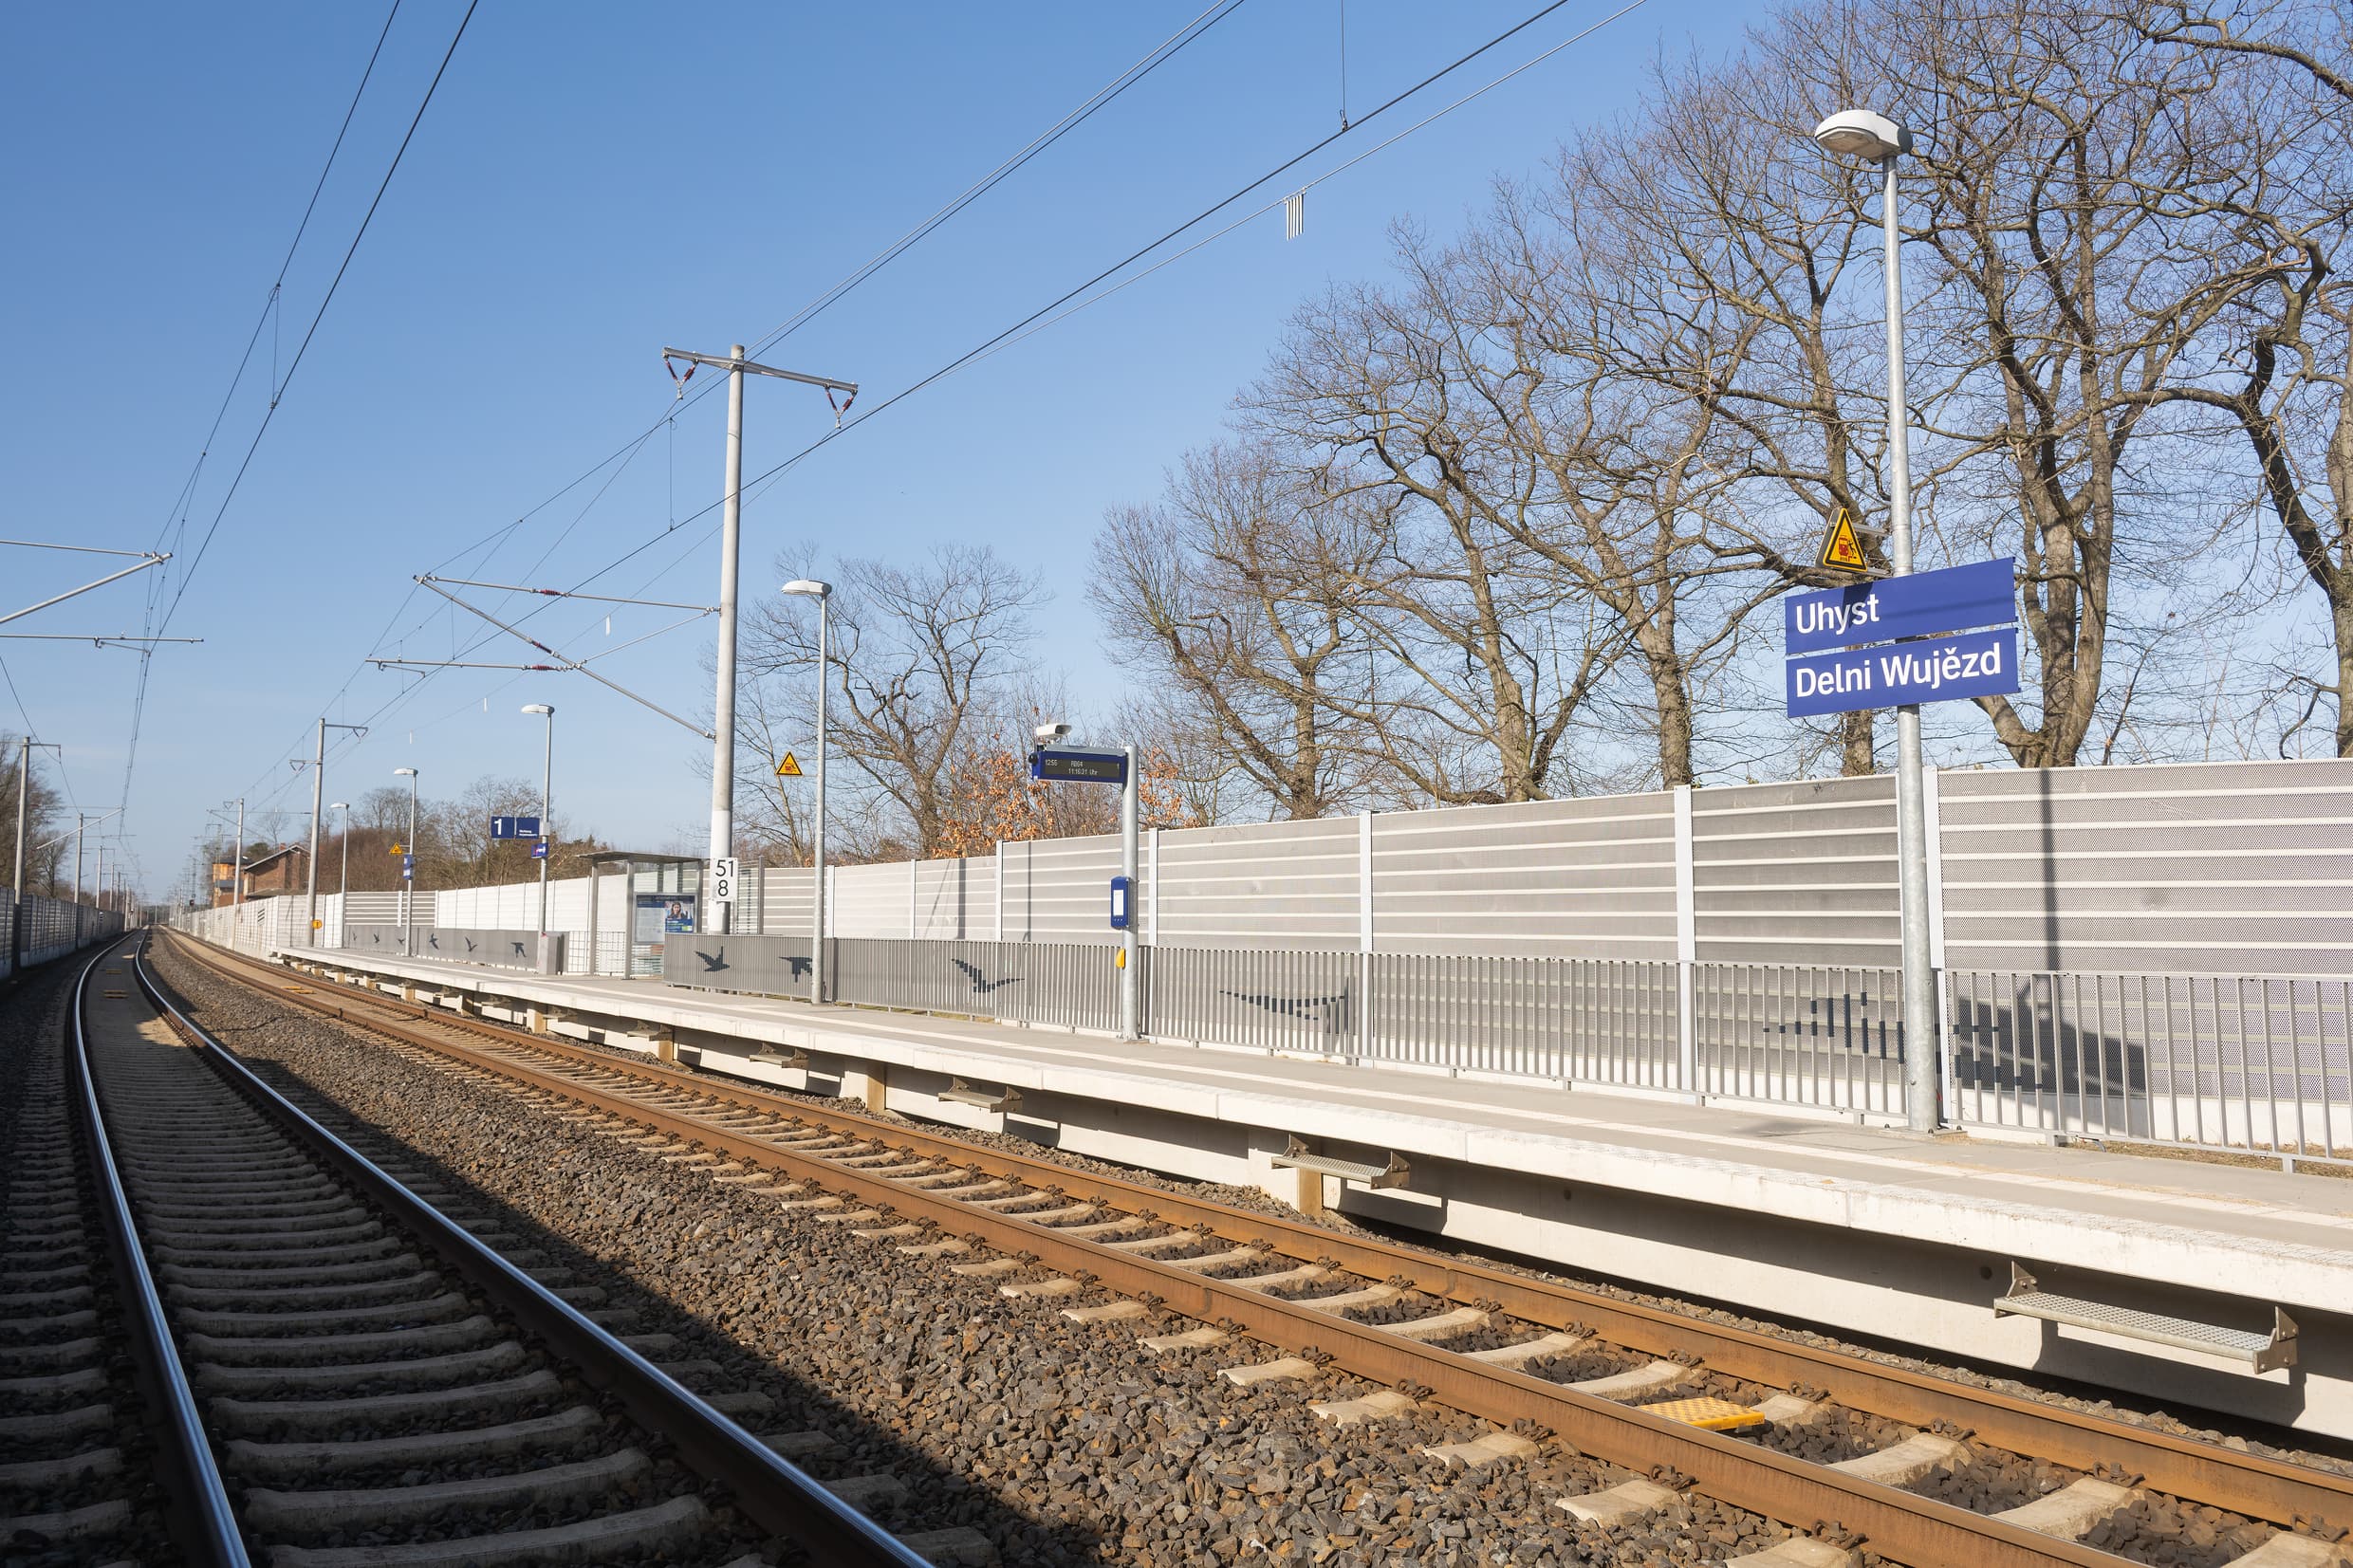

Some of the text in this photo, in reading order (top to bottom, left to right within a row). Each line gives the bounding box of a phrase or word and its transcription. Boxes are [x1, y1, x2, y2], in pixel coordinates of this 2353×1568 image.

[1795, 594, 1880, 636] Uhyst
[1795, 642, 2001, 698] Delni Wujězd
[494, 818, 502, 836] 1
[715, 858, 733, 877] 51
[717, 879, 729, 896] 8
